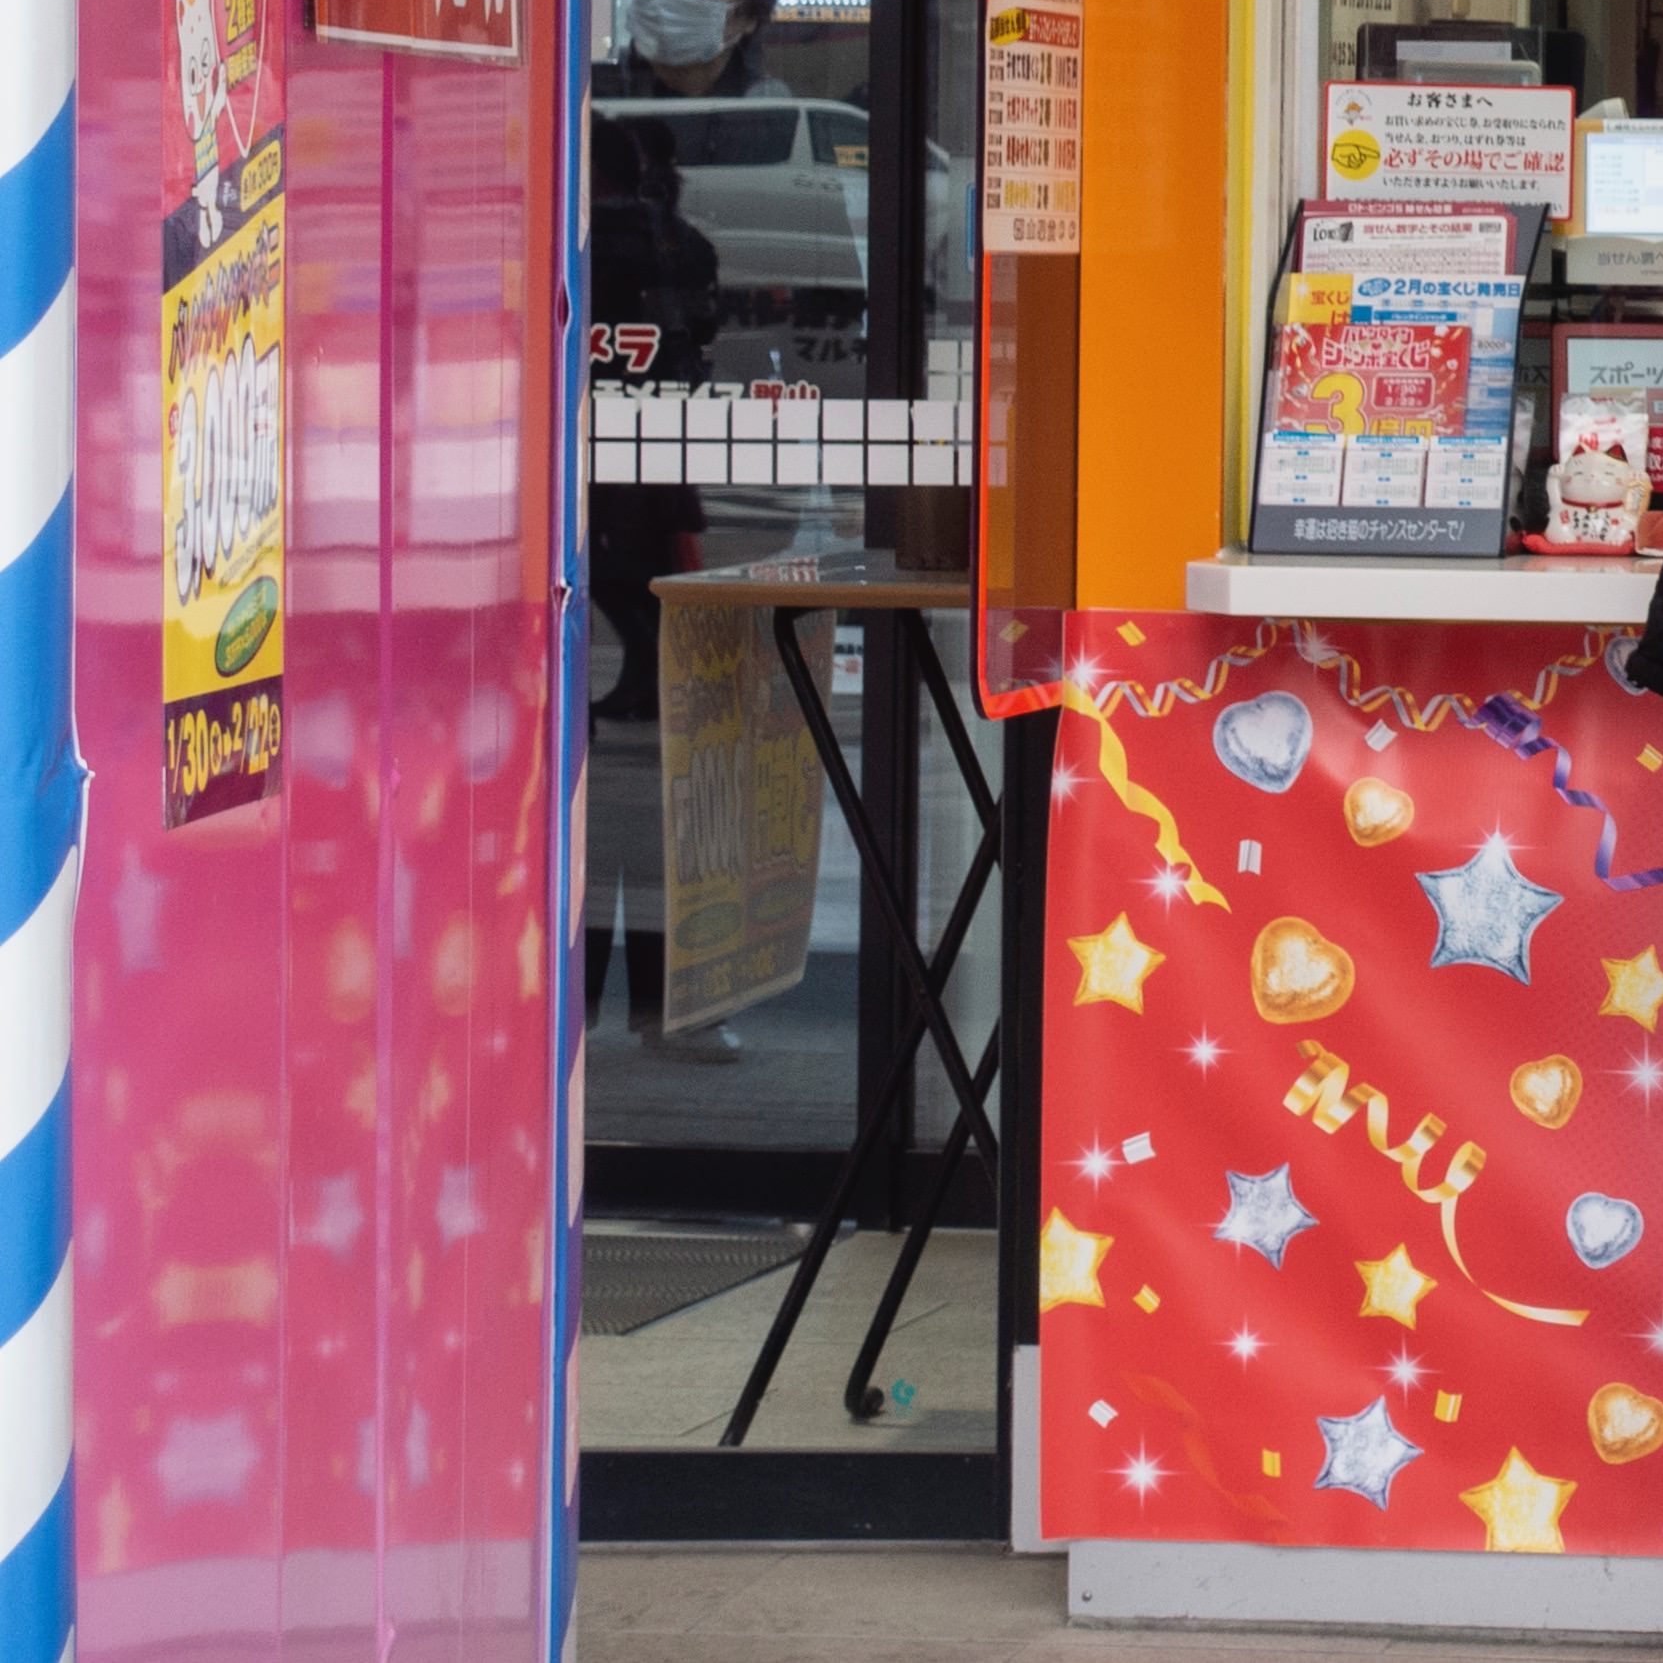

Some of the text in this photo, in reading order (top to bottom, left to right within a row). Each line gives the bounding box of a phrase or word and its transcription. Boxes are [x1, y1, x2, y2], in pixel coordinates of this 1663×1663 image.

[1407, 92, 1493, 109] お客さまへ
[1384, 148, 1566, 173] 必ずその場でご確認
[1311, 290, 1349, 306] 宝くじ
